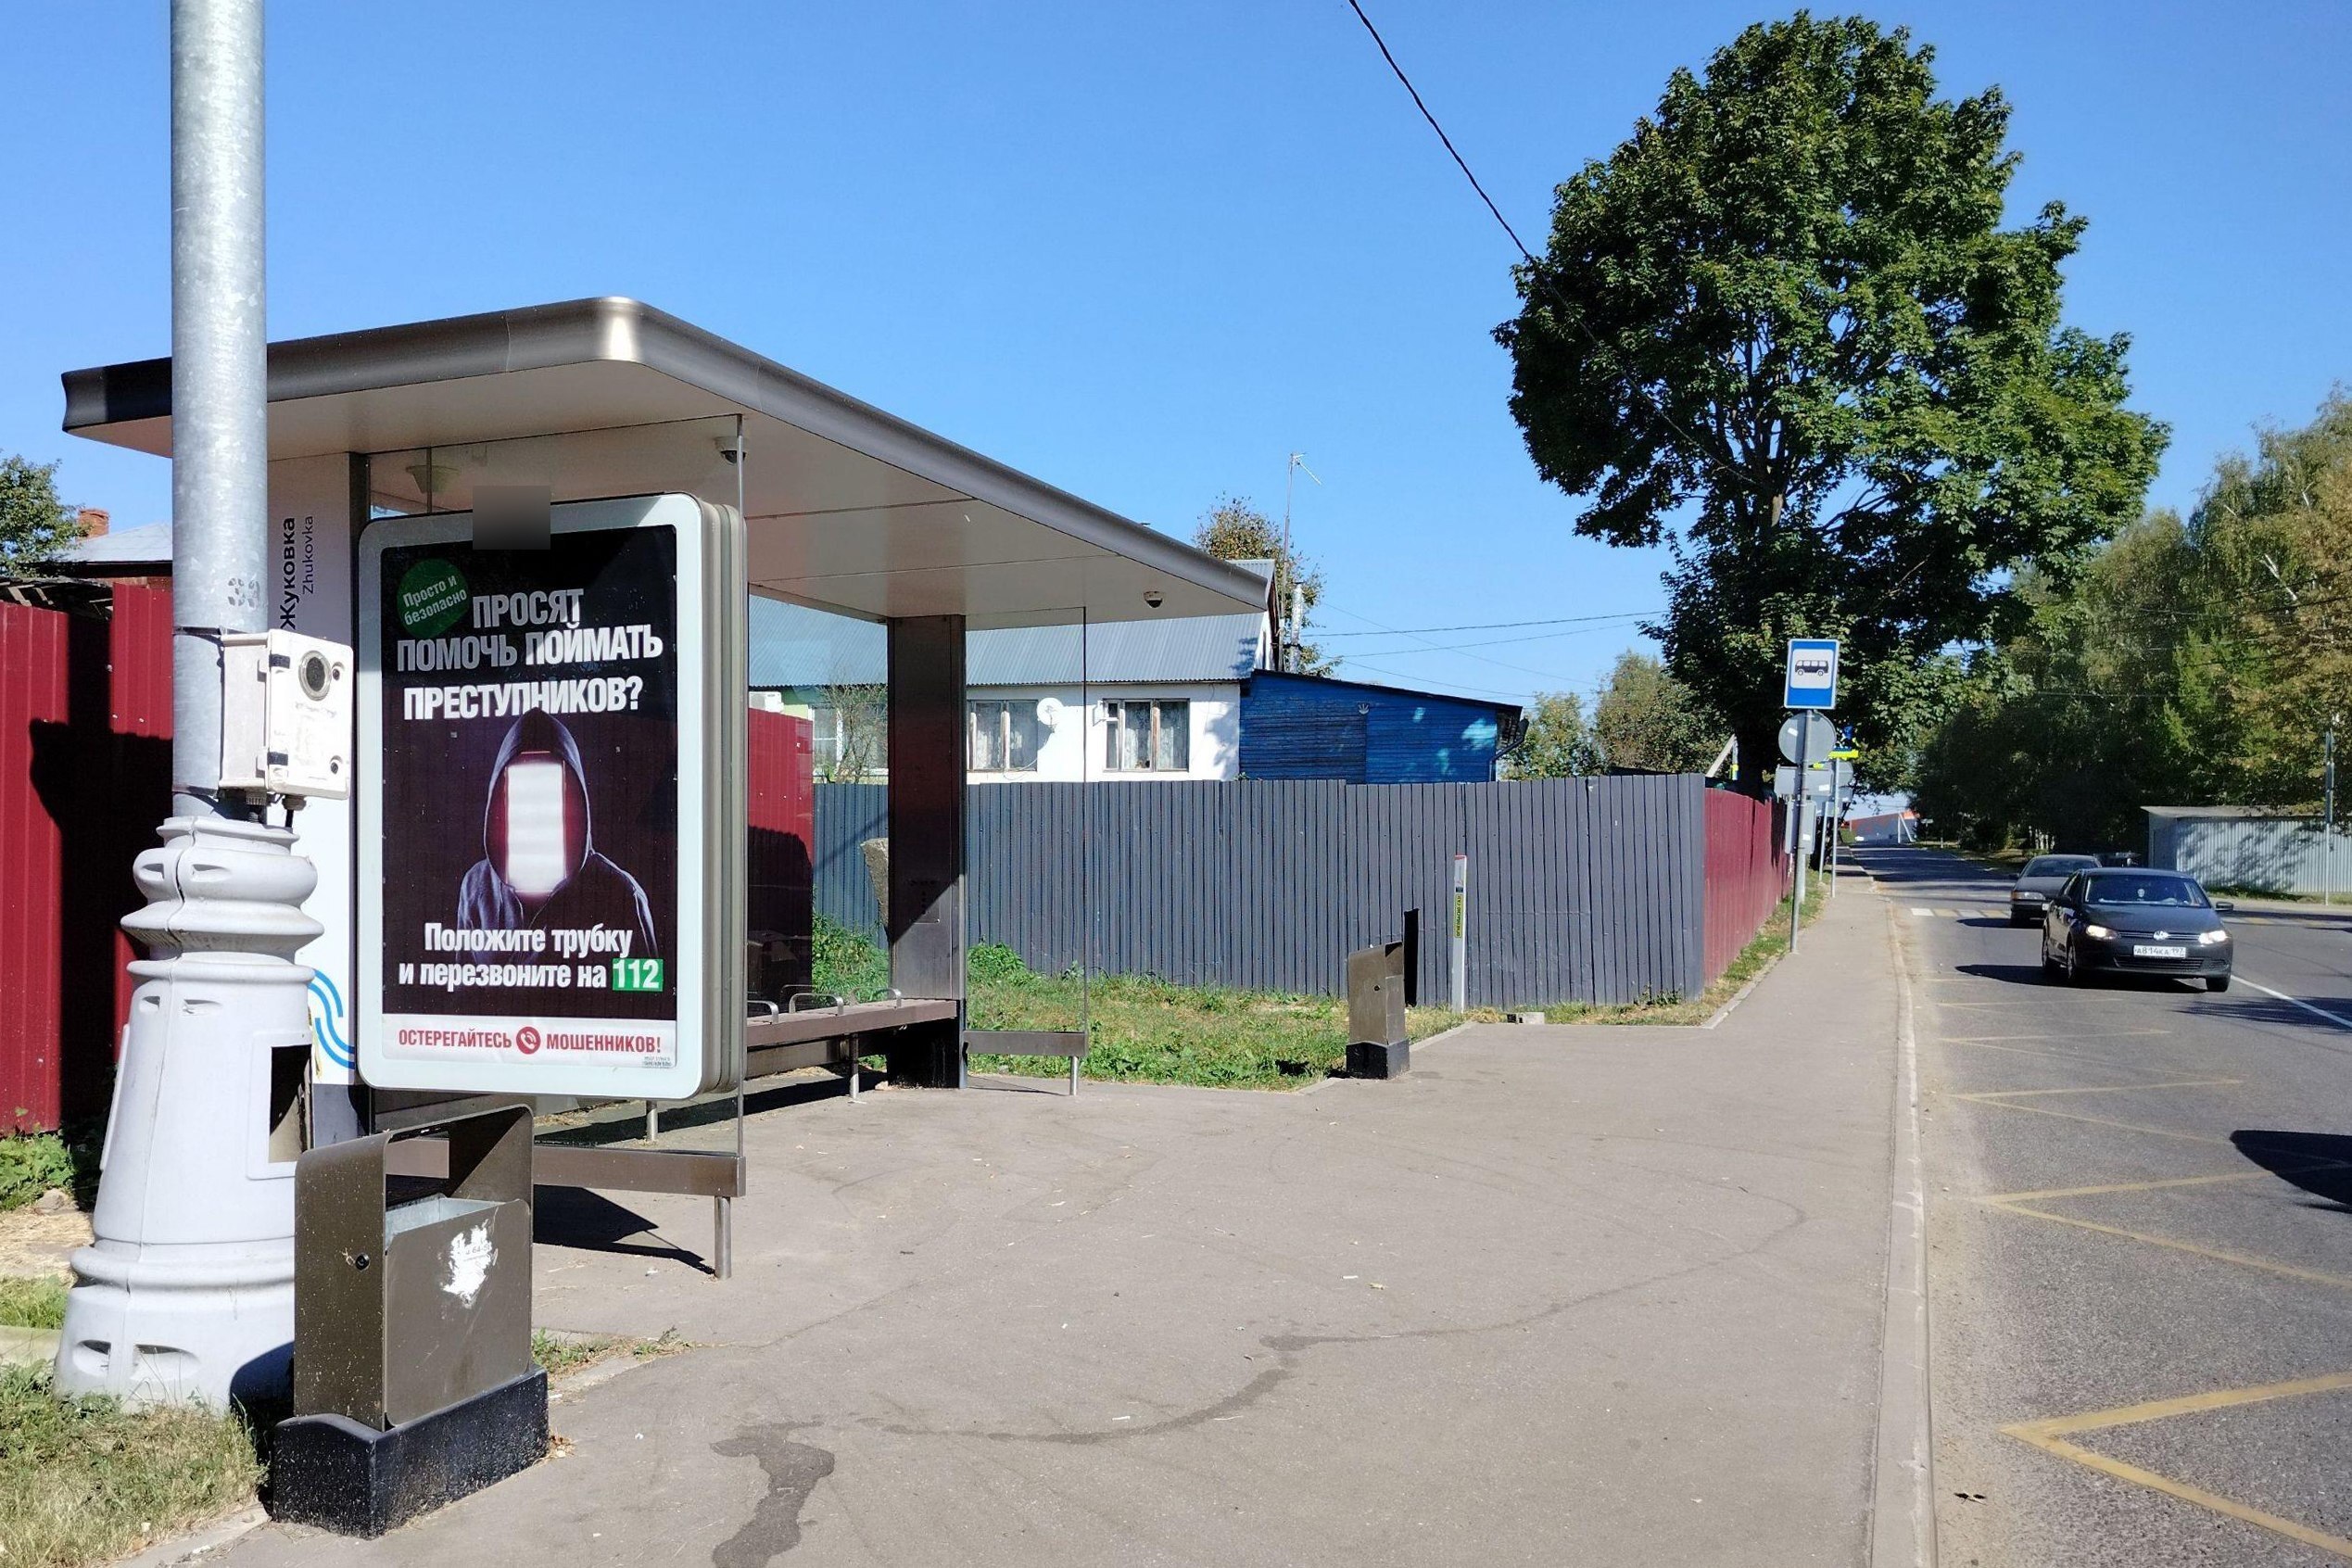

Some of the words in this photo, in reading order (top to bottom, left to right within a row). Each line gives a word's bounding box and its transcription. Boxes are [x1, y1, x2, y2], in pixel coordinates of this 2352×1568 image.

[280, 517, 299, 630] Жуковка
[302, 515, 313, 594] Zhukovka
[403, 582, 447, 608] Просто
[448, 575, 458, 588] и
[404, 588, 468, 626] безопасно
[473, 588, 585, 629] ПРОСЯТ
[397, 634, 518, 673] ПОМОЧЬ
[525, 621, 664, 666] ПОЙМАТЬ
[403, 676, 644, 721] ПРЕСТУПНИКОВ?
[424, 922, 546, 953] Положите
[551, 923, 633, 958] трубку
[398, 963, 413, 985] и
[420, 963, 572, 993] перезвоните
[576, 965, 607, 989] на
[613, 959, 660, 989] 112
[398, 1028, 512, 1049] ОСТЕРЕГАЙТЕСЬ
[546, 1035, 661, 1054] МОШЕННИКОВ!
